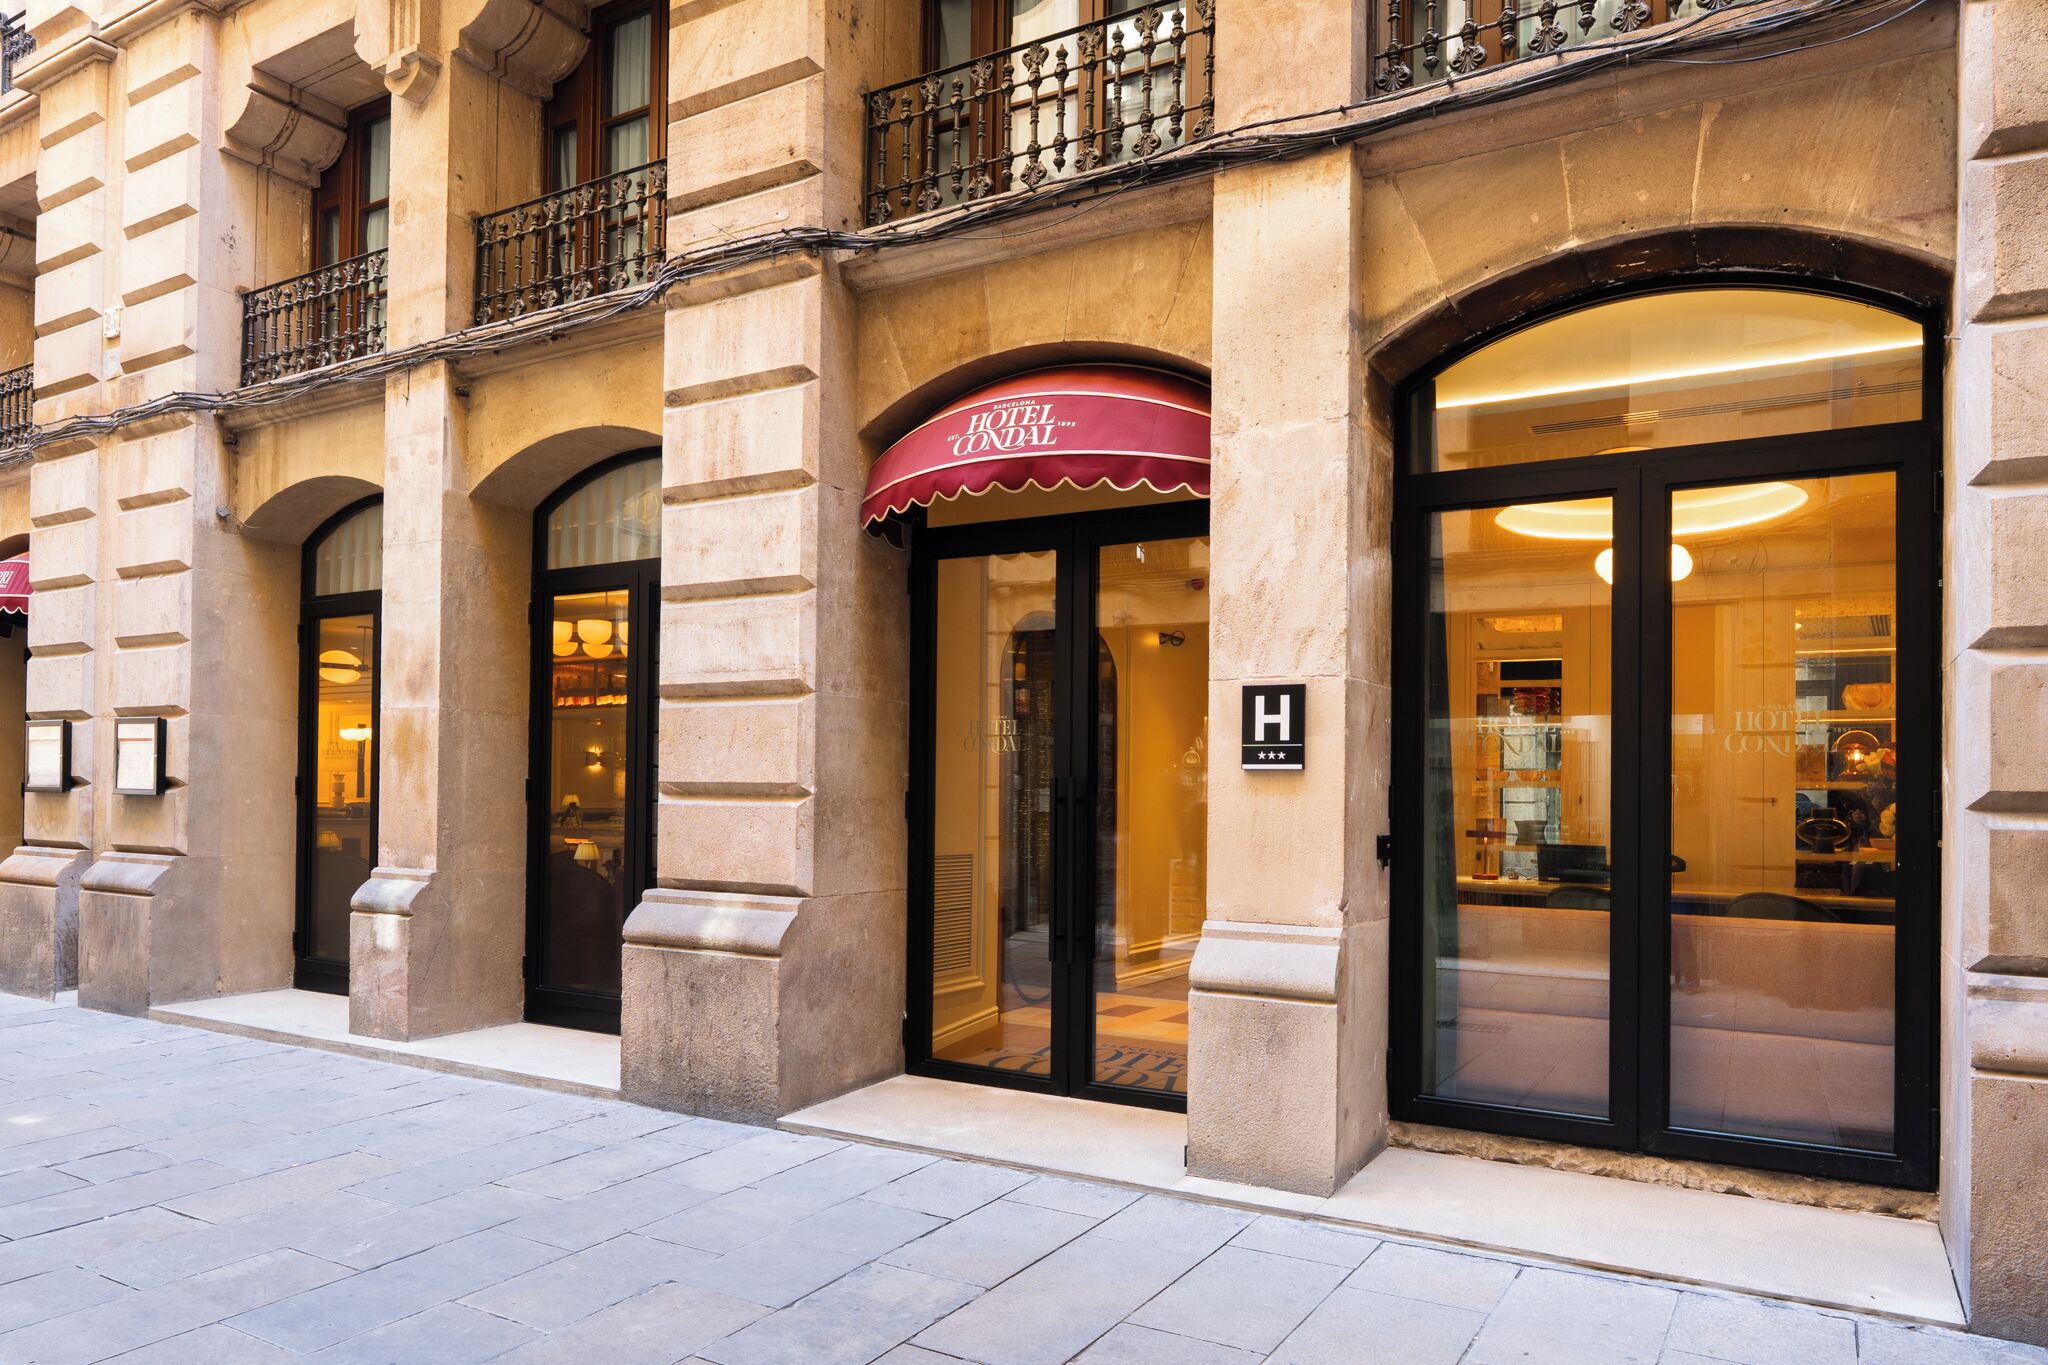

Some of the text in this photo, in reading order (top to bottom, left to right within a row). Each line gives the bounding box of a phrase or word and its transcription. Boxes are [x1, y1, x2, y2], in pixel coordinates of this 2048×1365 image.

[965, 404, 1056, 435] HOTEL
[993, 399, 1036, 410] BARCELONA
[952, 424, 1058, 456] CONDAL
[1255, 694, 1290, 741] H
